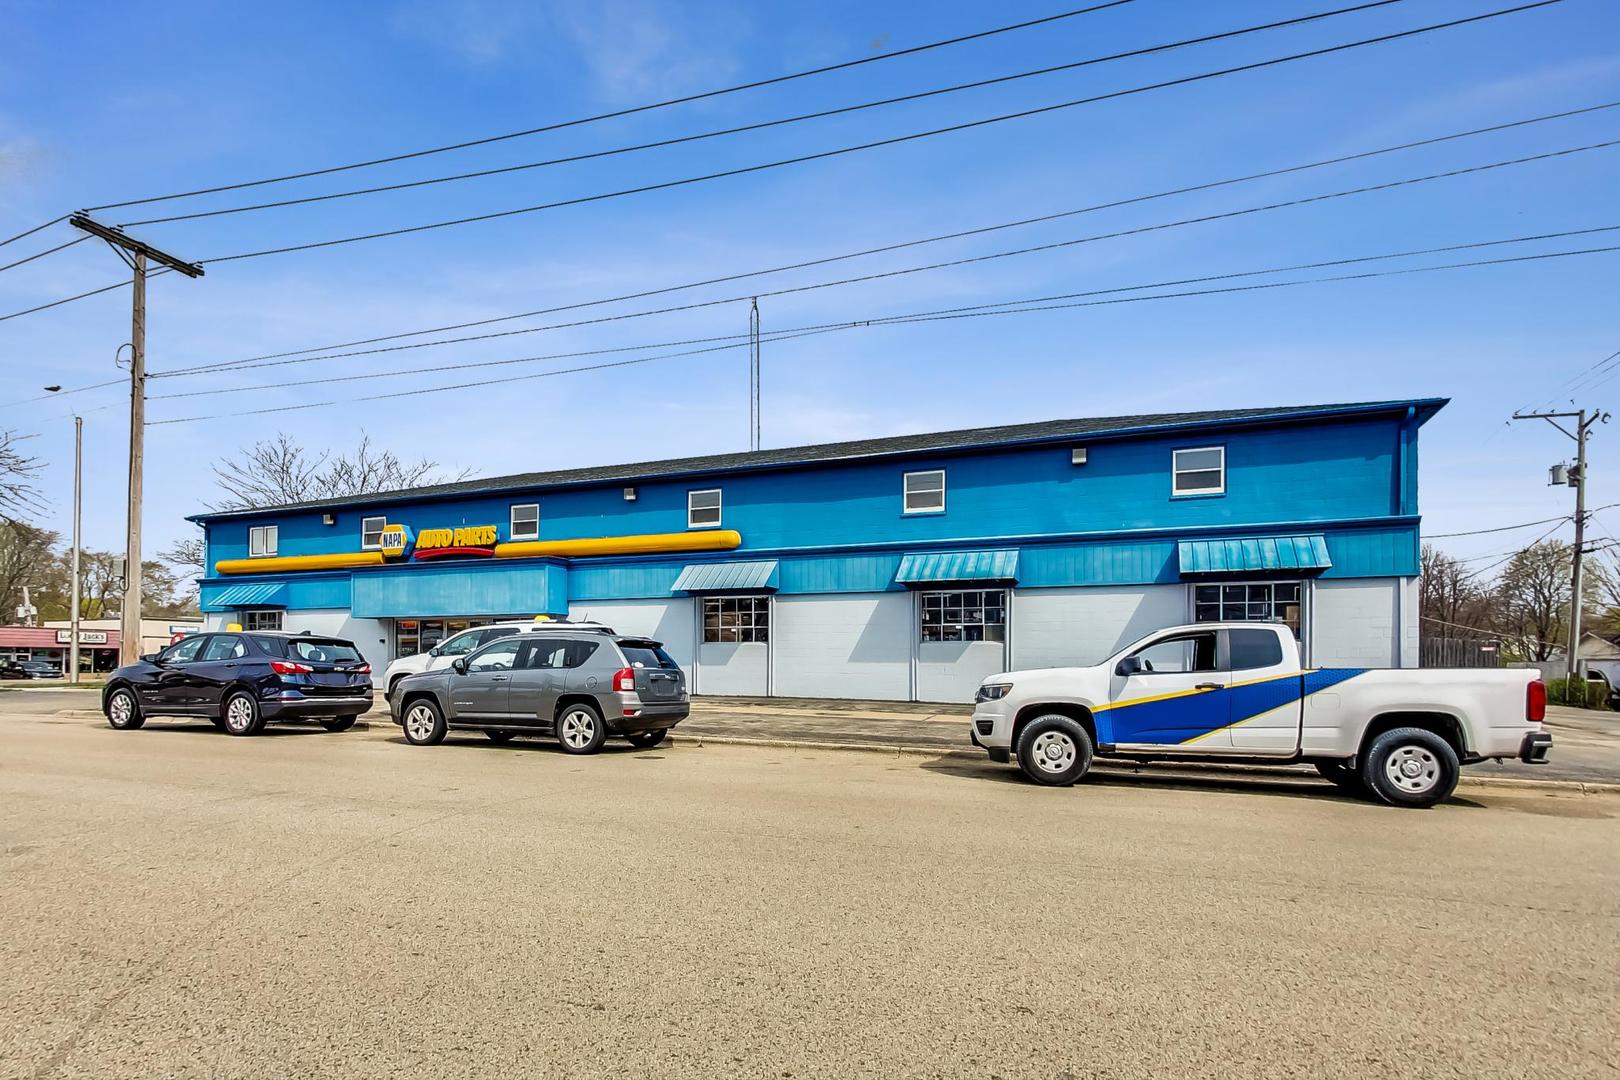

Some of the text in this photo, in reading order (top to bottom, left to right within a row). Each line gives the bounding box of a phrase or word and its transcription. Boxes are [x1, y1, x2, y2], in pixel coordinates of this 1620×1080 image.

[383, 533, 402, 547] NAPA
[415, 525, 497, 548] AUTO PARTS
